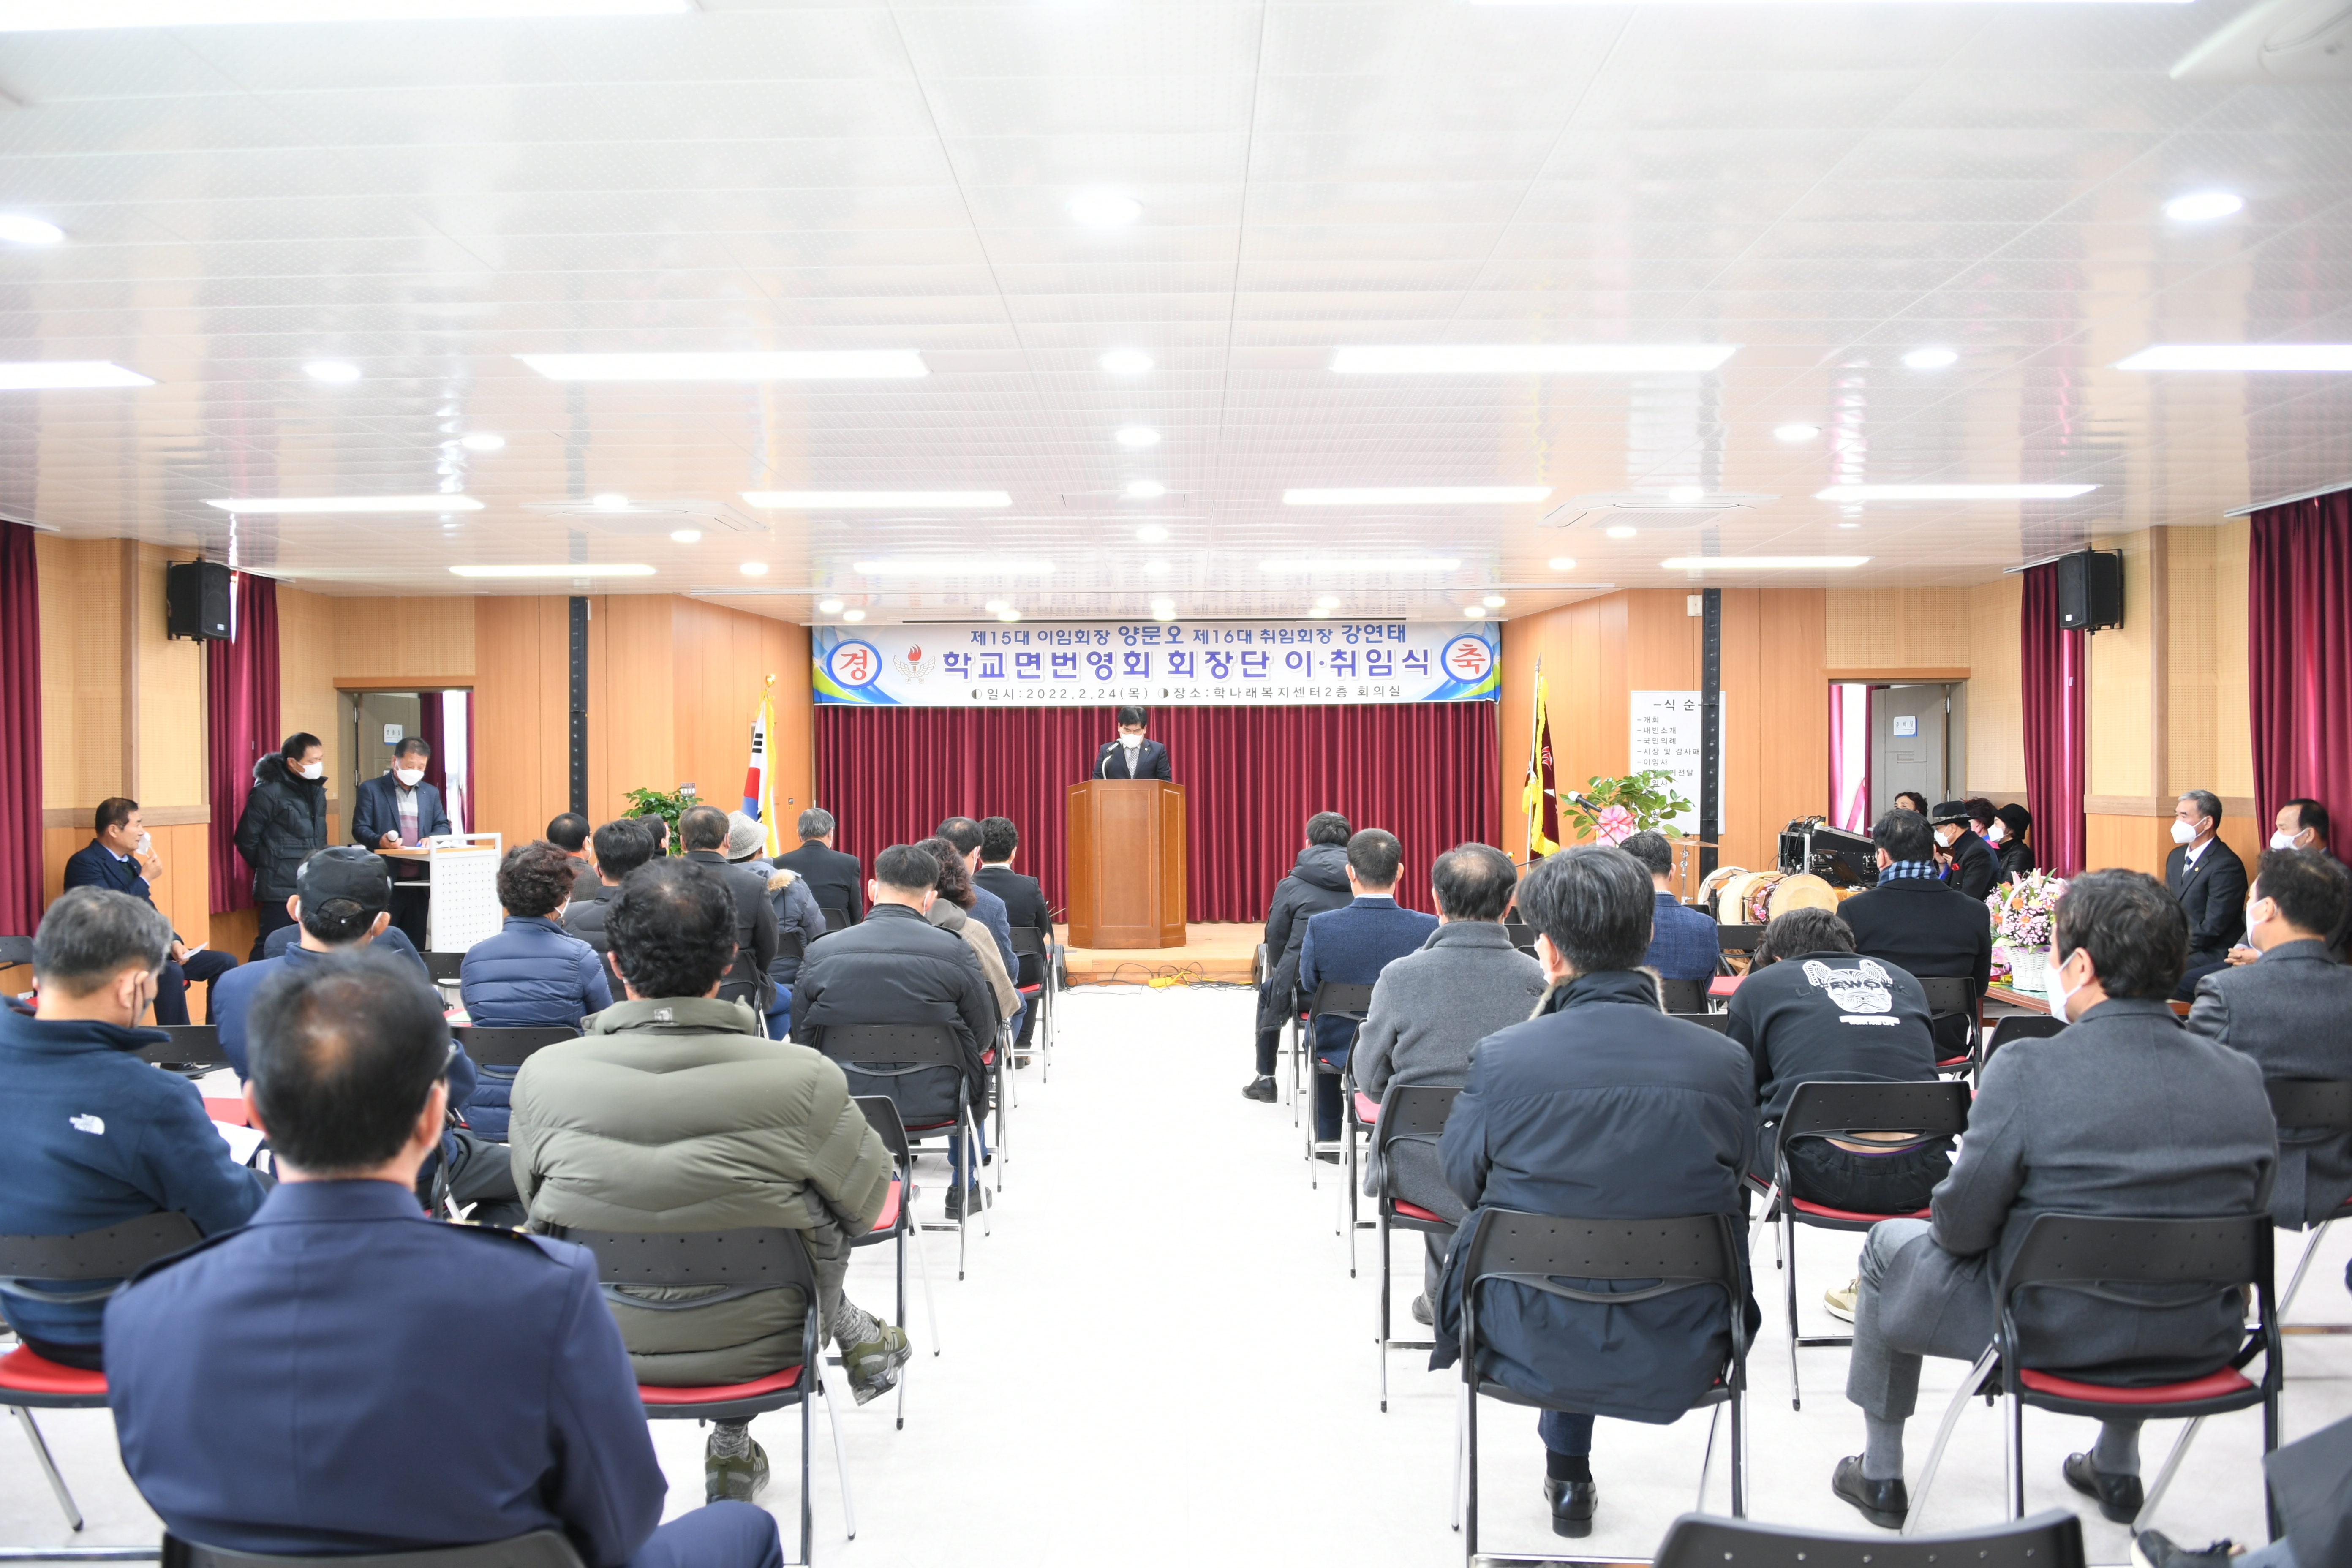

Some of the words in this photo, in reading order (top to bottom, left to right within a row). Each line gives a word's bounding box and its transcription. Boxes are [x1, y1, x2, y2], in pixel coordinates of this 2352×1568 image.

[971, 630, 1029, 645] 제15대
[1037, 629, 1110, 645] 이임회장
[1118, 626, 1184, 646] 양문오
[1193, 629, 1252, 644] 제16대
[1260, 629, 1333, 644] 취임회장
[1342, 624, 1405, 644] 강연태
[839, 649, 867, 680] 경
[943, 651, 1149, 681] 학교면번영회
[1168, 650, 1270, 679] 회장단
[1451, 644, 1486, 674] 축
[1357, 685, 1400, 697] 회의실
